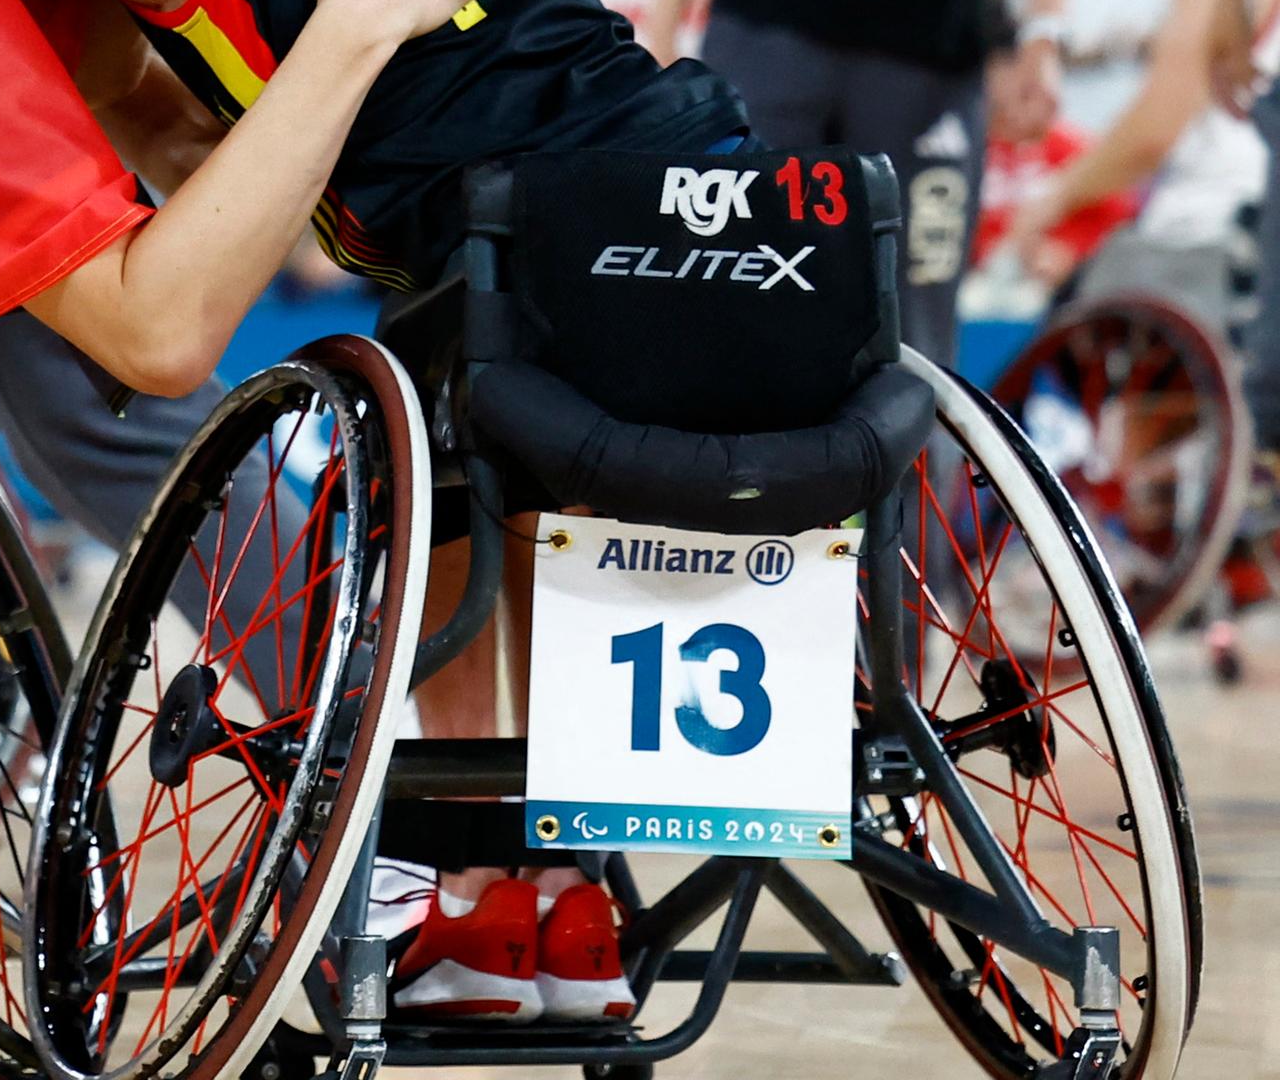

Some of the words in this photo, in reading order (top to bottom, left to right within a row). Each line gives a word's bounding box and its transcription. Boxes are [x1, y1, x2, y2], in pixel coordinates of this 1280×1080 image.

[659, 166, 760, 237] RGK
[775, 156, 849, 226] 13
[590, 244, 817, 291] ELITEX
[597, 538, 735, 575] Allianz
[610, 621, 772, 757] 13
[725, 819, 805, 844] 2024
